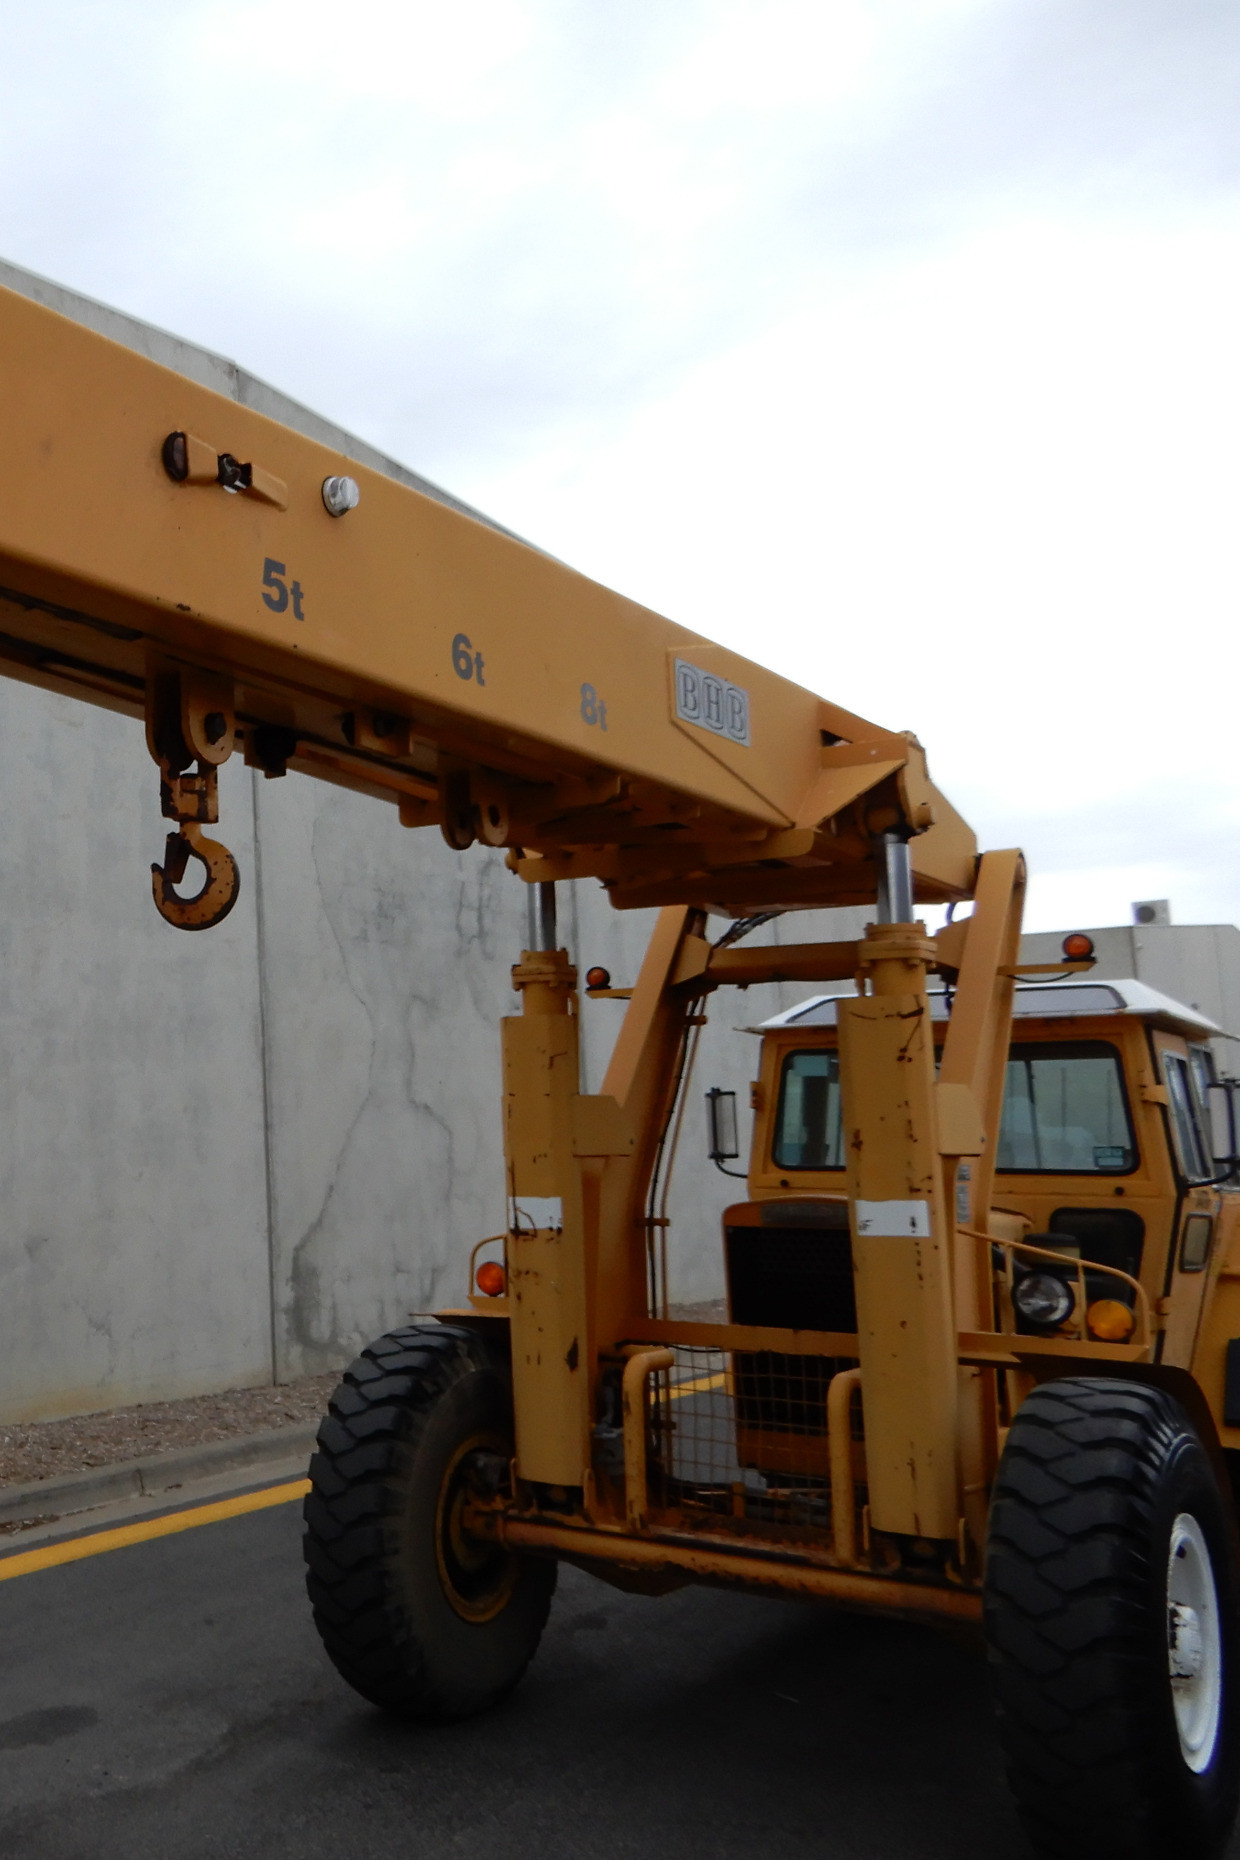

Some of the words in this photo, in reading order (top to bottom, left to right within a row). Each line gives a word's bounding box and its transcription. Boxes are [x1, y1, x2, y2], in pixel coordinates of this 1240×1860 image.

[261, 557, 304, 621] 5t
[452, 633, 485, 686] 6t
[580, 682, 607, 731] 8t
[677, 664, 747, 740] BHB
